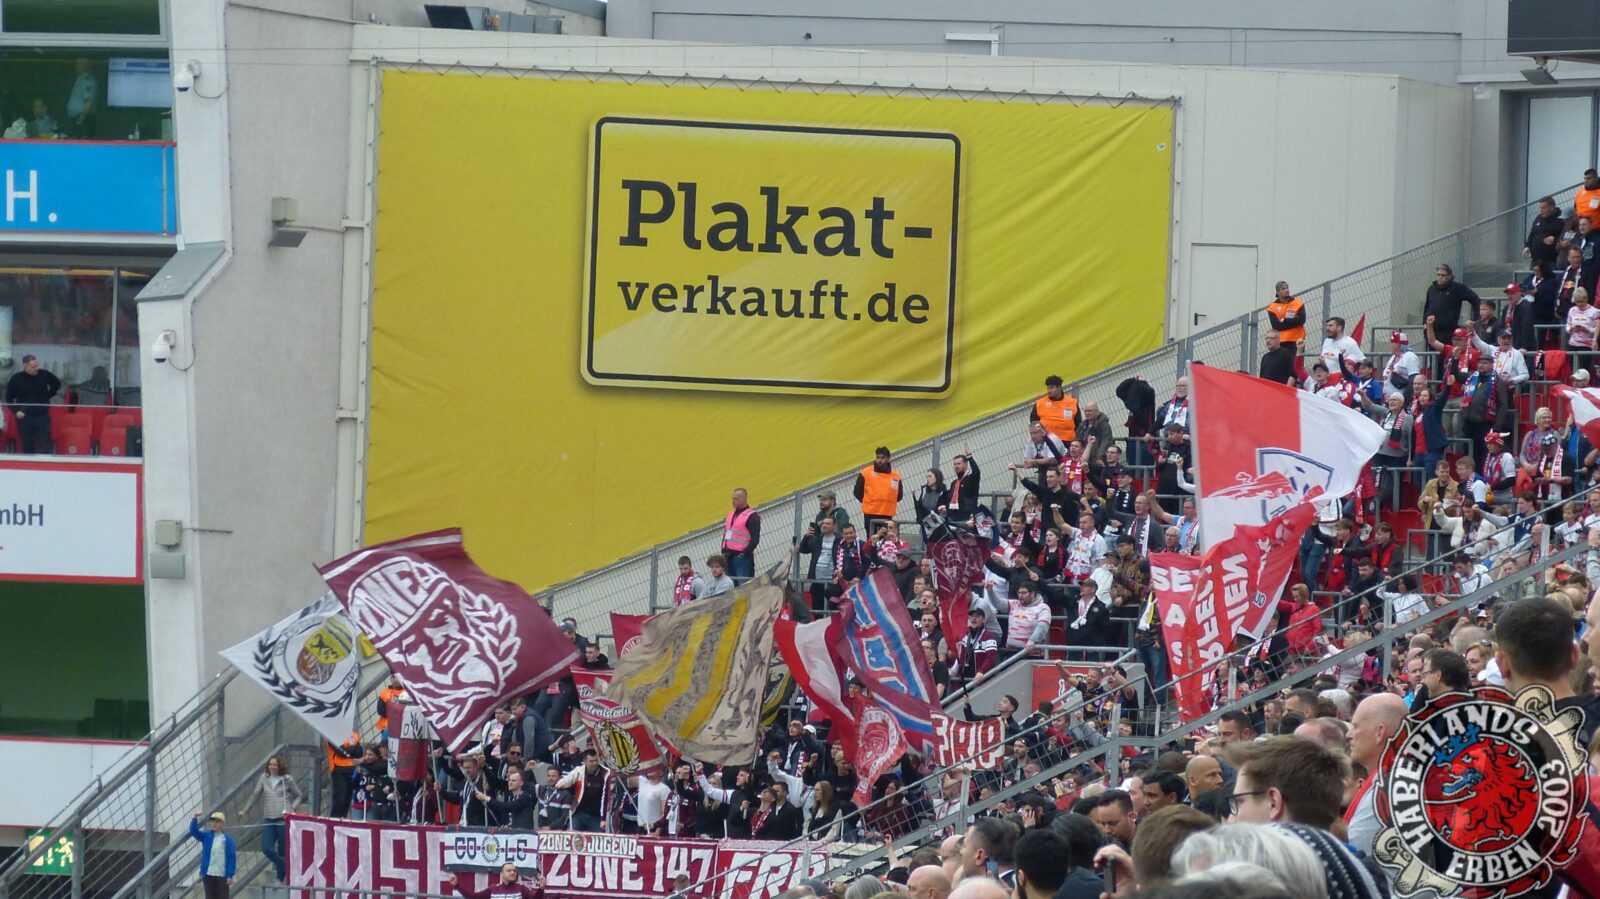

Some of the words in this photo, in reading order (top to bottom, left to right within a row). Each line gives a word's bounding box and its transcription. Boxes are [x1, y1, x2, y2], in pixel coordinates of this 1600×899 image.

[619, 178, 932, 259] Plakat-
[617, 275, 930, 324] verkauft.de
[352, 561, 429, 638] ZONE
[538, 834, 571, 850] ZONE
[588, 835, 638, 856] JUGEND
[550, 844, 643, 892] ZONE
[653, 844, 715, 893] 147
